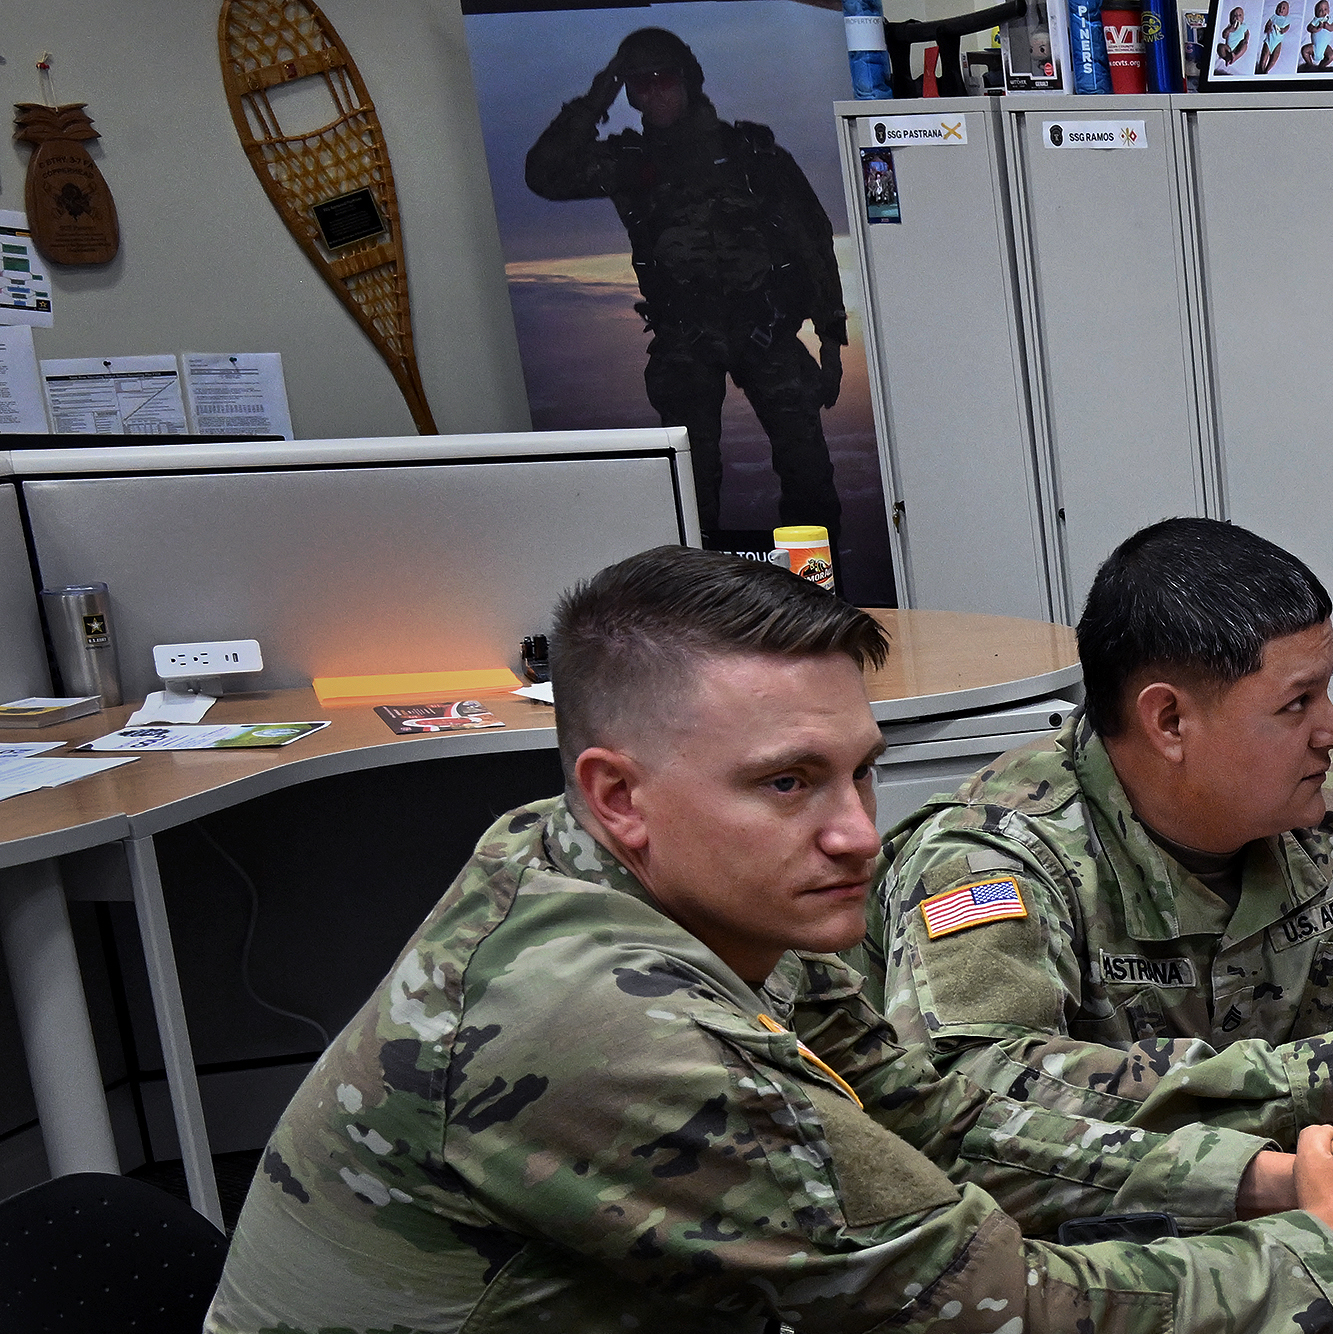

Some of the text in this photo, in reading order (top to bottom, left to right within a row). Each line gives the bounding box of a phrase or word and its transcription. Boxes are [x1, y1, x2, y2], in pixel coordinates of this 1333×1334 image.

[1077, 6, 1093, 73] PINERS
[887, 128, 943, 139] SSG PASTRANA
[1069, 132, 1115, 142] SSG RAMOS
[1282, 918, 1317, 943] U.S.
